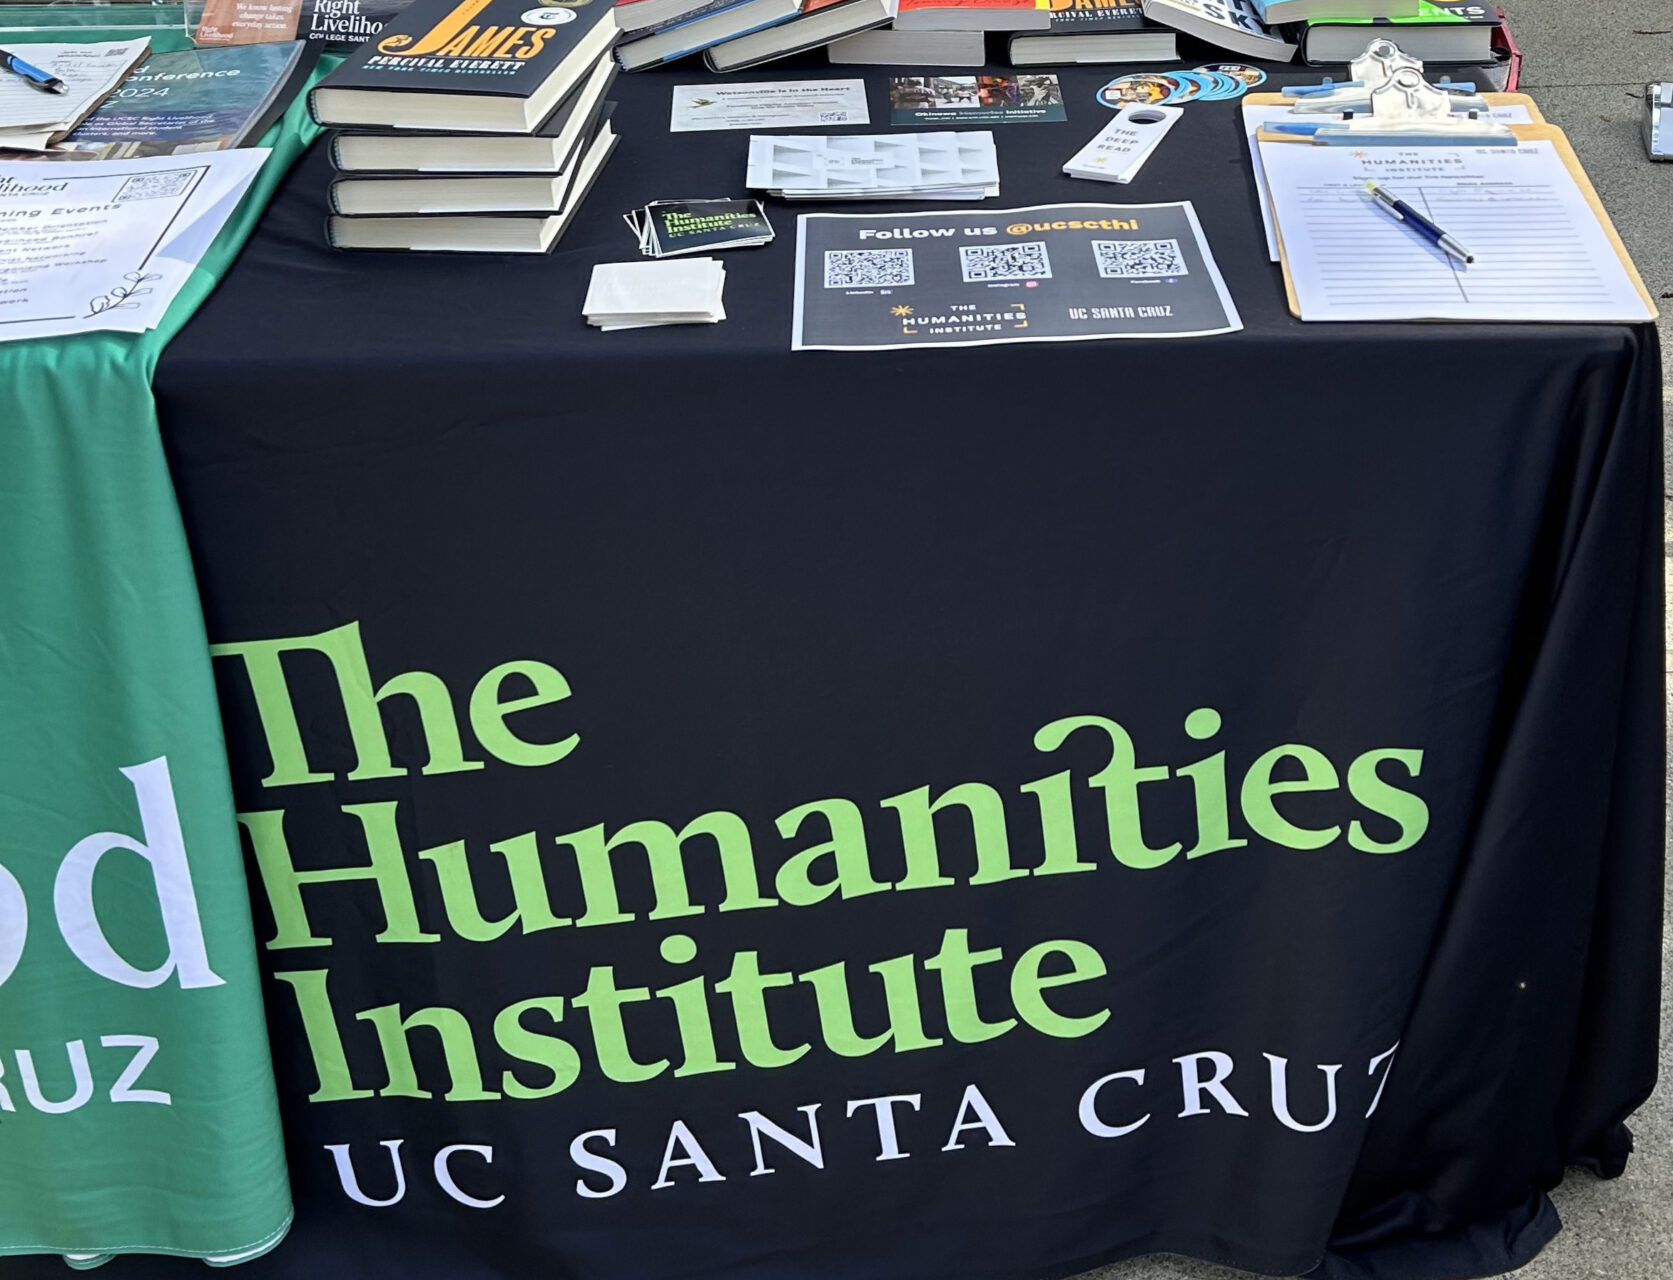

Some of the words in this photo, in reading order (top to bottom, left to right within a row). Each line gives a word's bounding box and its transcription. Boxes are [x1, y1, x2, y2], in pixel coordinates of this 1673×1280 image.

[310, 14, 388, 35] Liveliho
[347, 34, 371, 43] SANT
[367, 55, 445, 68] PERCIVAL
[449, 58, 527, 71] EVERETT
[1114, 128, 1139, 137] THE
[1105, 136, 1140, 144] DEEP
[1096, 144, 1132, 153] READ
[51, 204, 122, 215] Events
[662, 212, 692, 220] The
[664, 212, 757, 226] Humanities
[667, 220, 733, 234] Institute
[688, 226, 727, 235] SANTA
[859, 227, 956, 240] Follow
[964, 226, 998, 237] us
[1006, 219, 1140, 236] @ucscthi
[902, 311, 1027, 325] HUMANITIES
[1068, 307, 1088, 320] UC
[1091, 306, 1134, 319] SANTA
[1138, 305, 1174, 318] CRUZ
[929, 324, 1002, 334] INSTITUTE
[210, 620, 581, 787] The
[237, 707, 1430, 950] Humanities
[273, 928, 1112, 1103] Institute
[323, 1139, 506, 1209] UC
[569, 1083, 1017, 1199] SANTA
